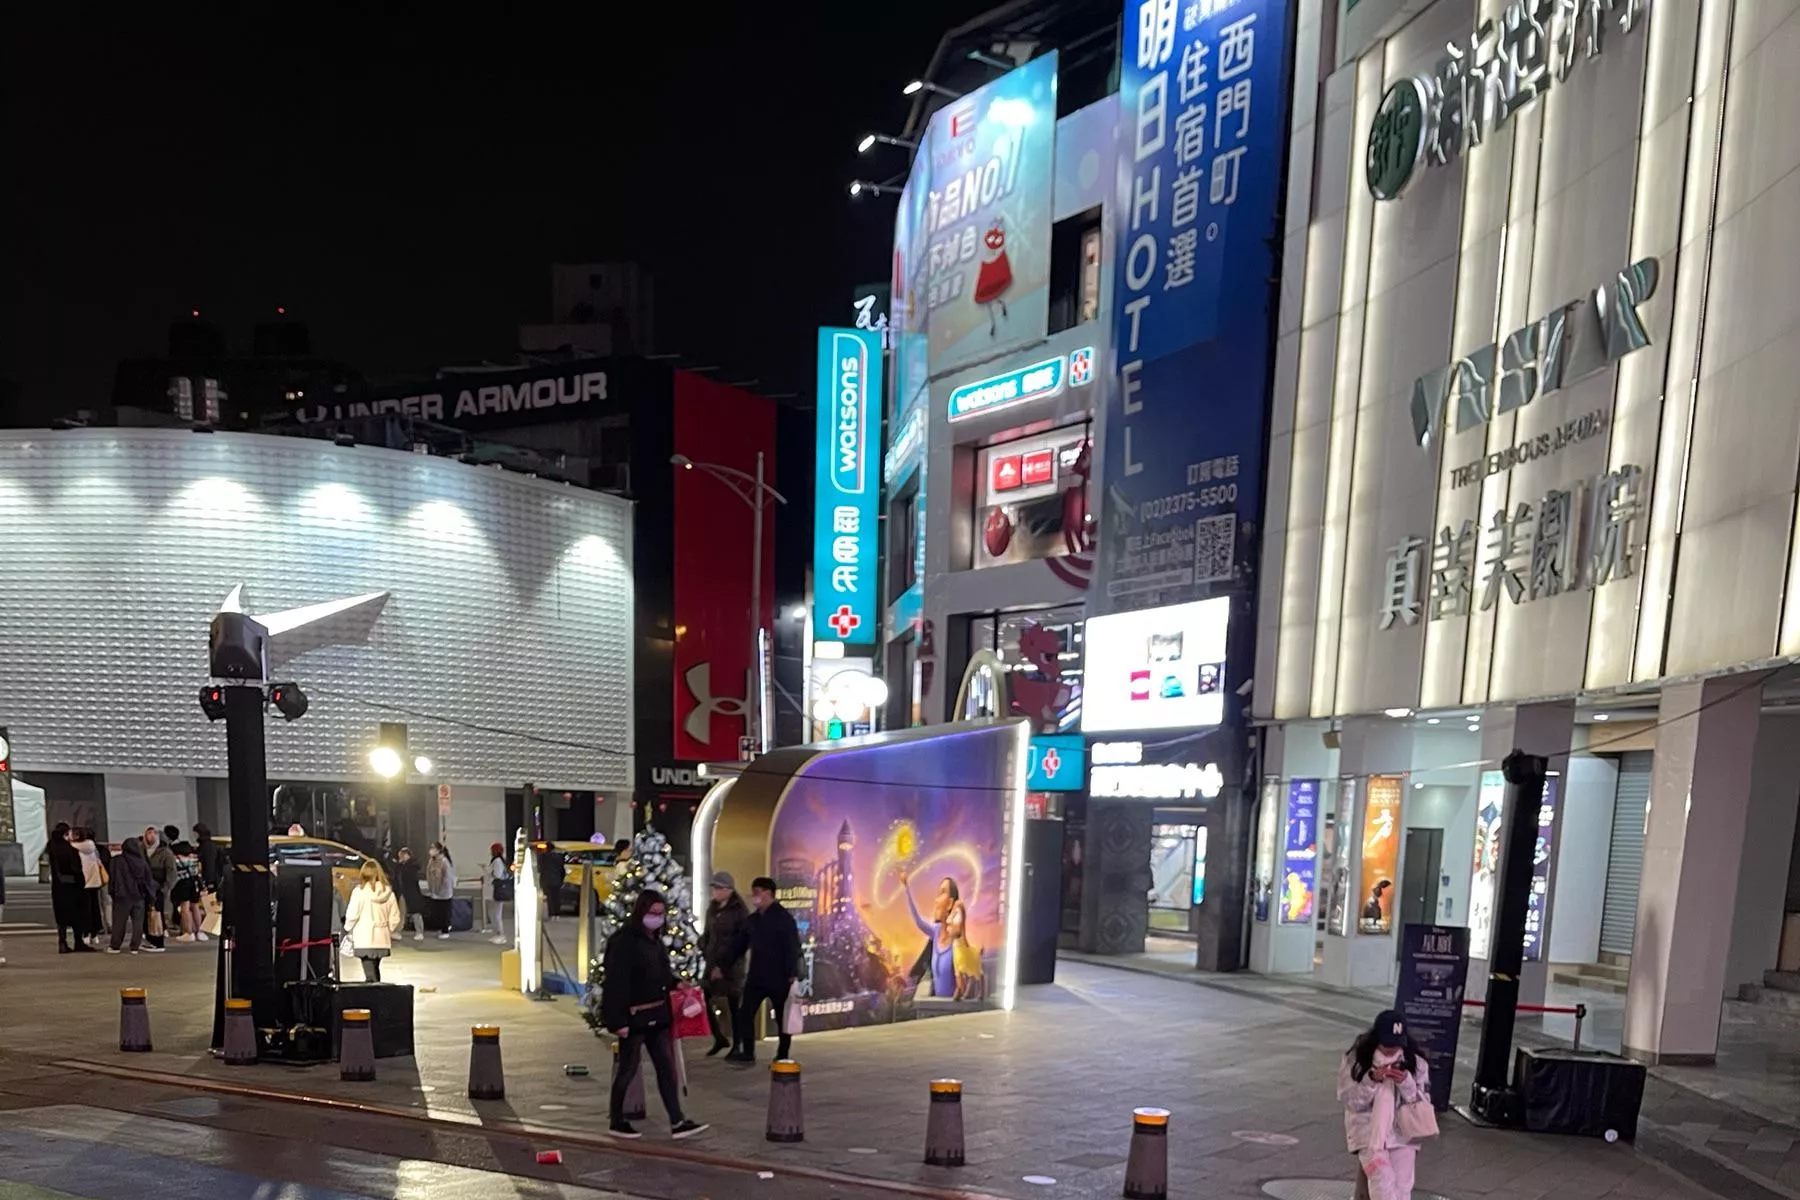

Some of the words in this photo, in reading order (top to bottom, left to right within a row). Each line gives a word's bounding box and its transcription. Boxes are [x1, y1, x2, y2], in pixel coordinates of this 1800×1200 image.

[1163, 39, 1210, 291] 住宿首選
[453, 371, 607, 419] ARMOUR
[839, 355, 858, 473] watsons
[1450, 432, 1550, 490] TREENDOUS
[832, 505, 861, 593] 屈臣氏
[1379, 463, 1644, 630] 真善美劇院
[651, 766, 714, 786] UND
